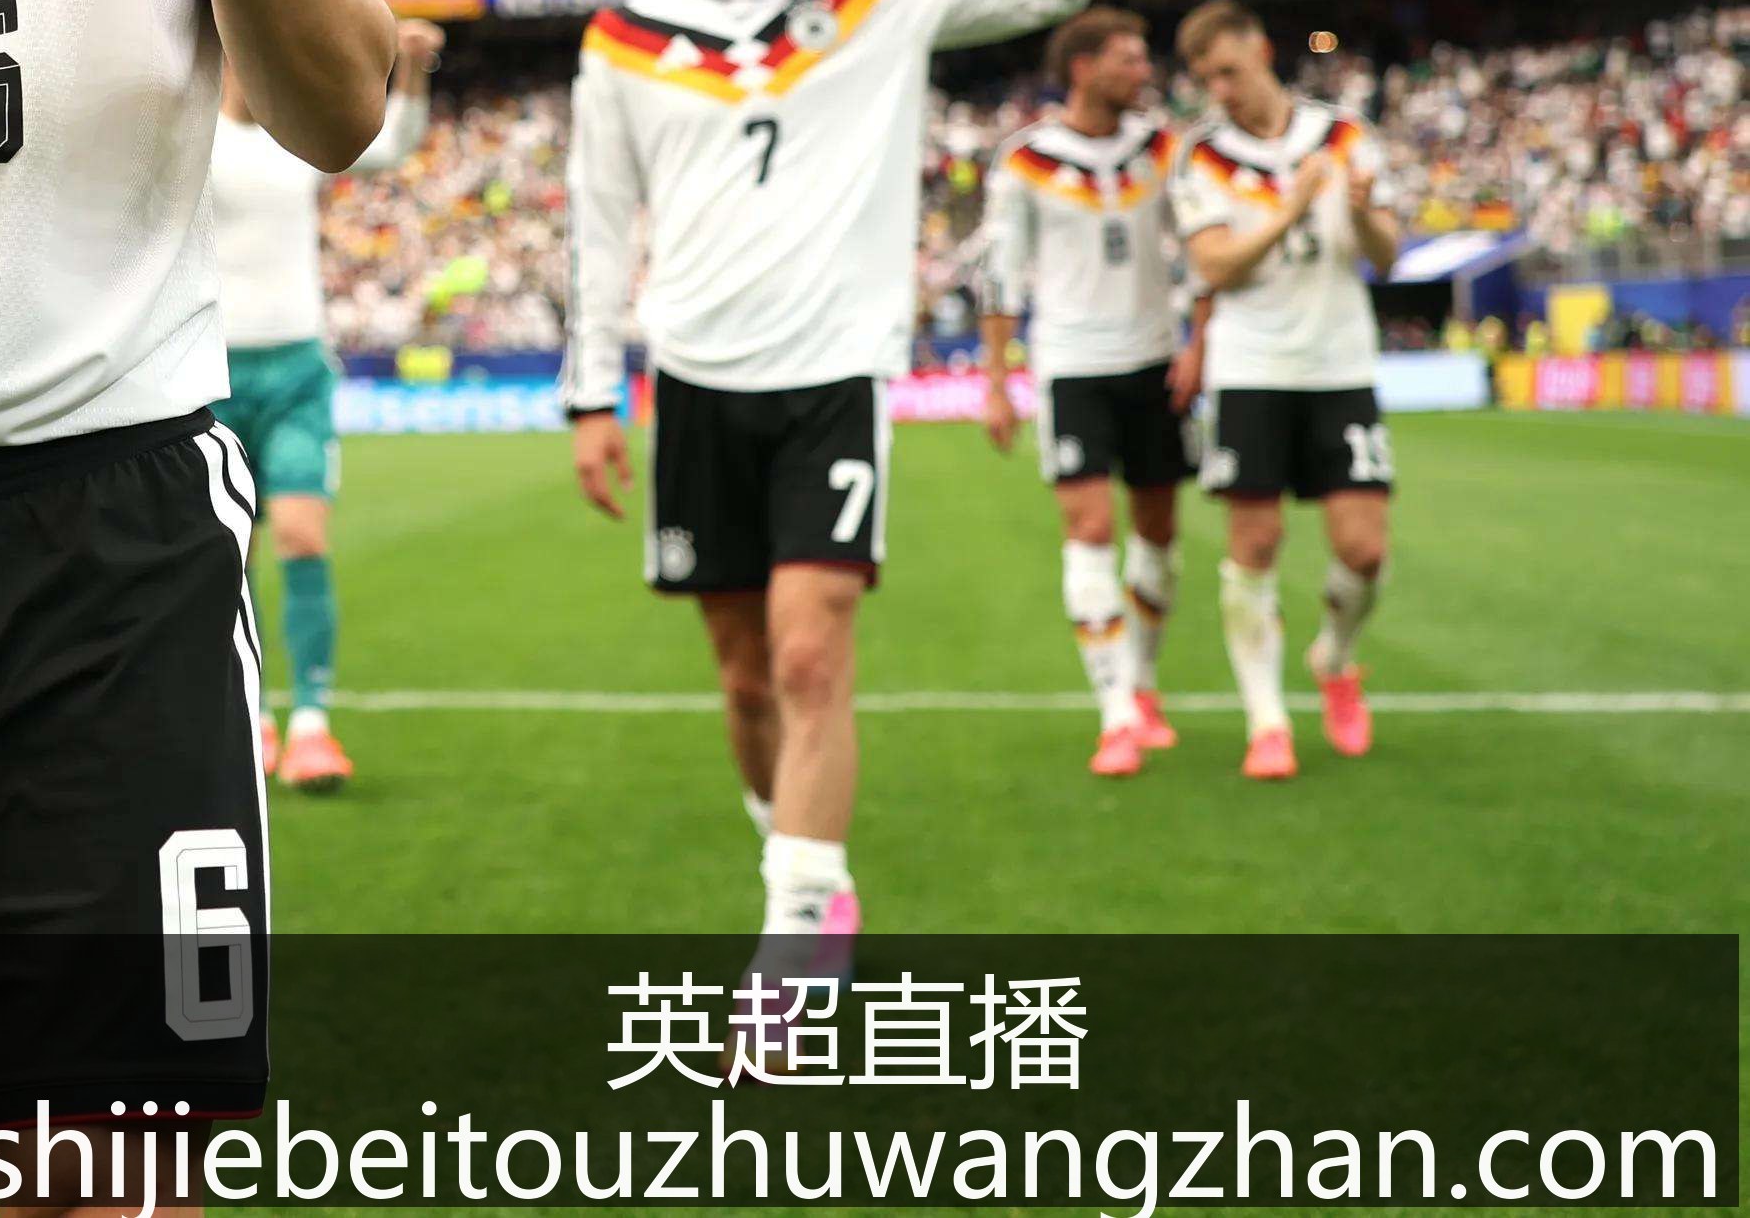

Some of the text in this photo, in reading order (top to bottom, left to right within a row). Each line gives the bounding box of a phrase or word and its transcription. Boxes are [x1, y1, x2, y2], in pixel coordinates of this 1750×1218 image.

[745, 118, 778, 184] 7
[828, 458, 874, 542] 7
[158, 828, 253, 1041] 6
